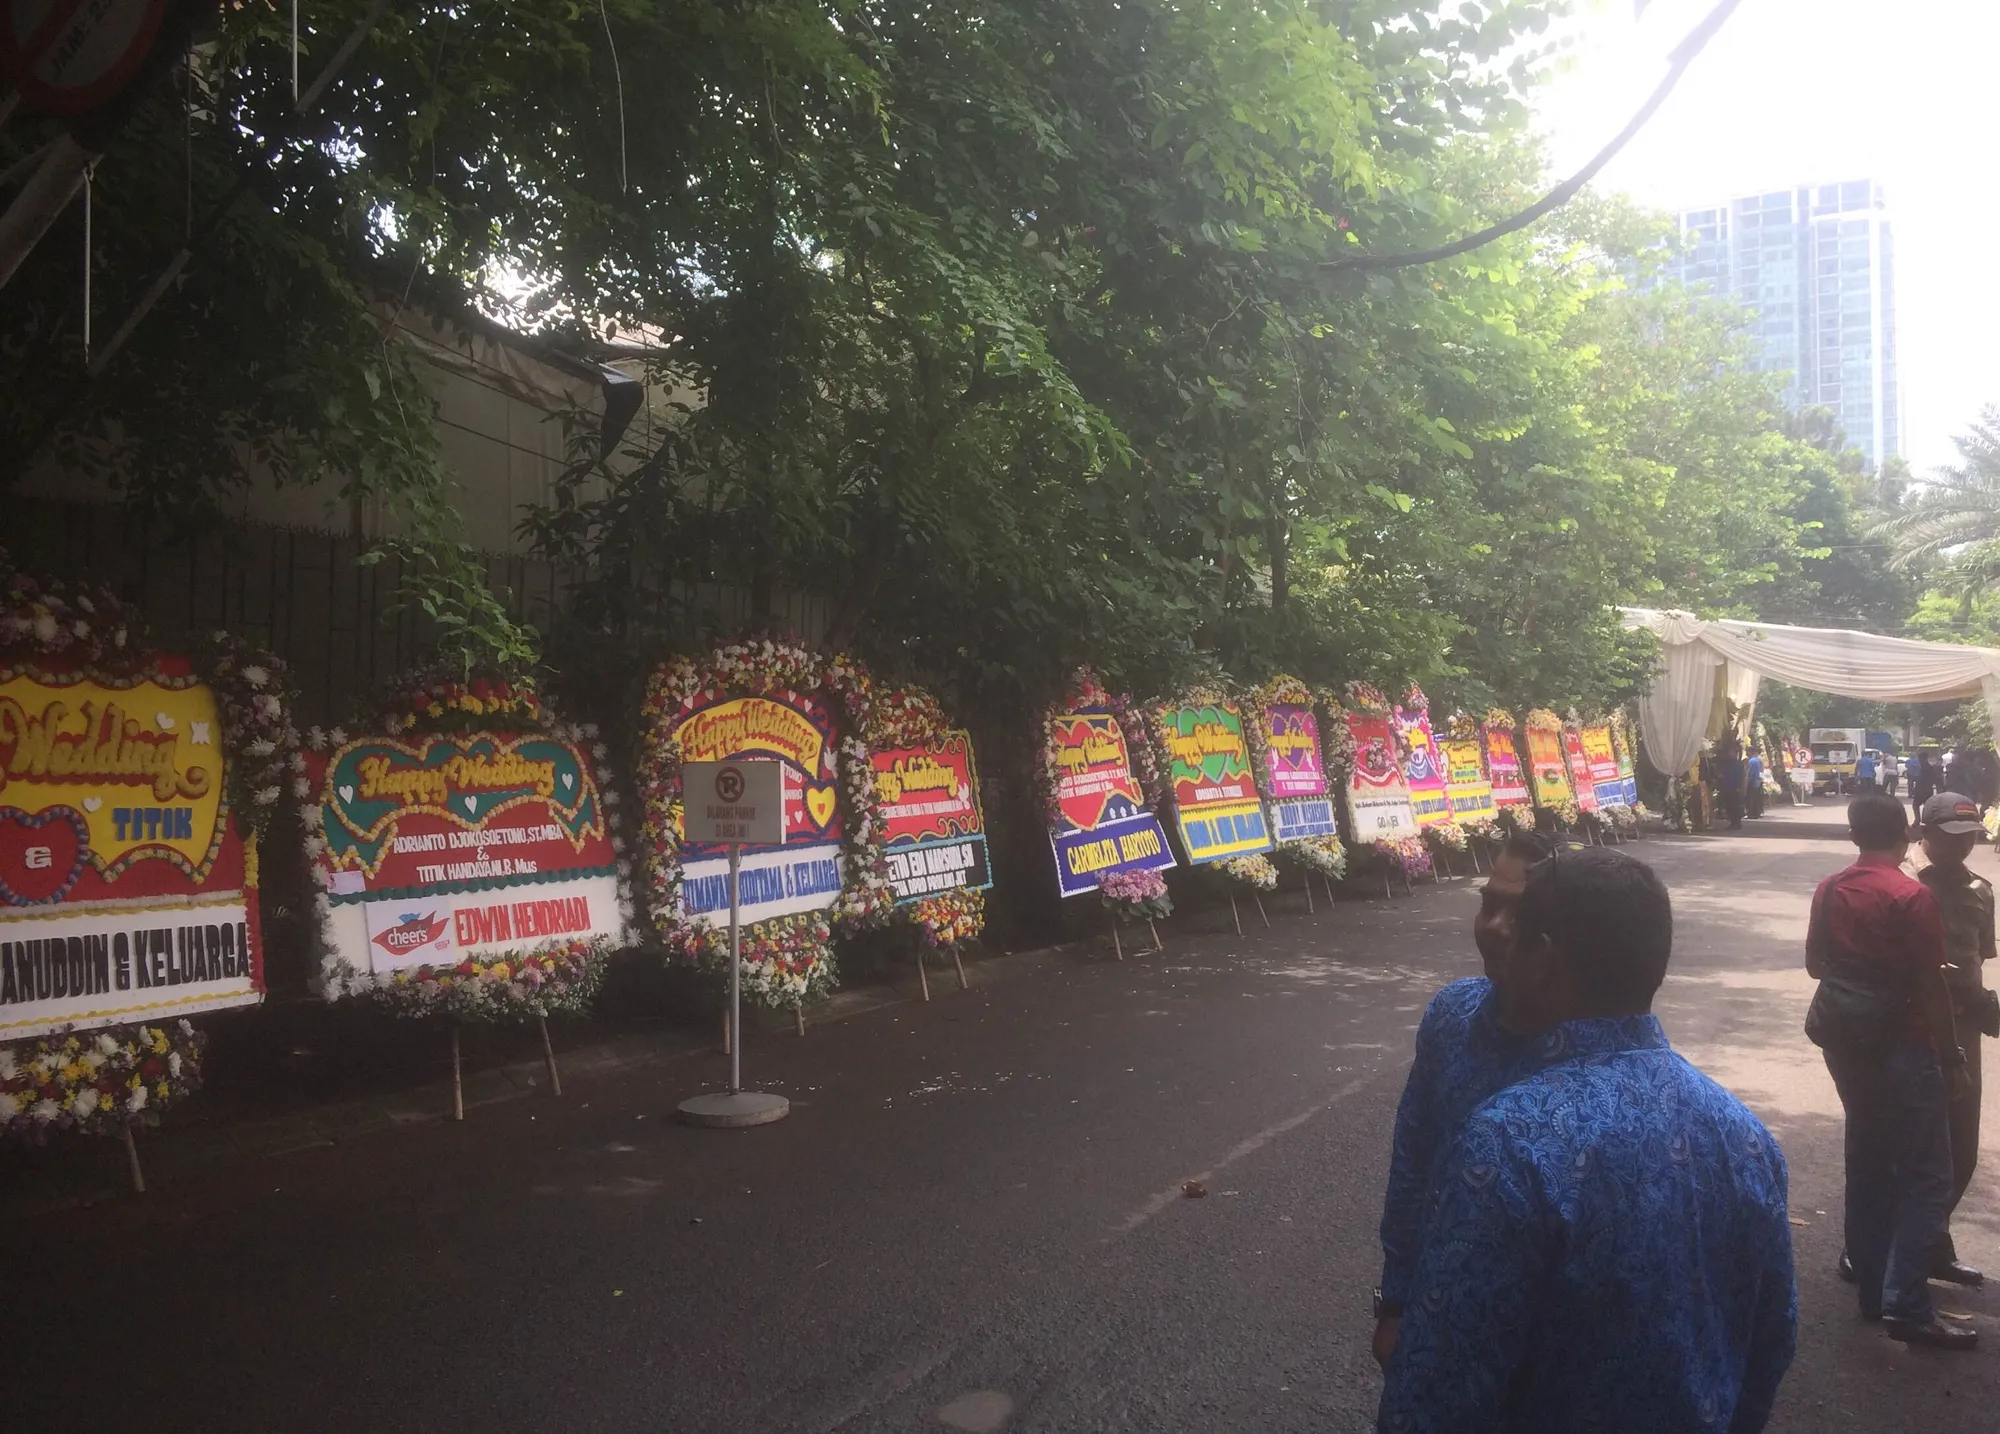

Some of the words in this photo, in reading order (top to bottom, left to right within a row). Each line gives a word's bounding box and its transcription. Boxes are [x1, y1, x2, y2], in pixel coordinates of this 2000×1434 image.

[0, 696, 209, 801] Wedding
[682, 713, 745, 761] Happy
[741, 700, 816, 764] Wedding
[358, 756, 449, 804] Happy
[447, 752, 555, 799] Wedding
[895, 756, 958, 797] Wedding
[112, 808, 193, 841] TITIK
[393, 832, 447, 854] ADRIANTO
[416, 865, 447, 883] TITIK
[514, 858, 537, 874] Mus
[477, 846, 490, 861] &
[1067, 838, 1121, 876] CARMELITA
[794, 858, 842, 898] KELUARGA
[387, 927, 428, 946] cheers
[454, 904, 511, 948] EDWIN
[511, 895, 592, 940] HENDRIADI
[113, 932, 131, 991] &
[134, 921, 251, 990] KELUARGA
